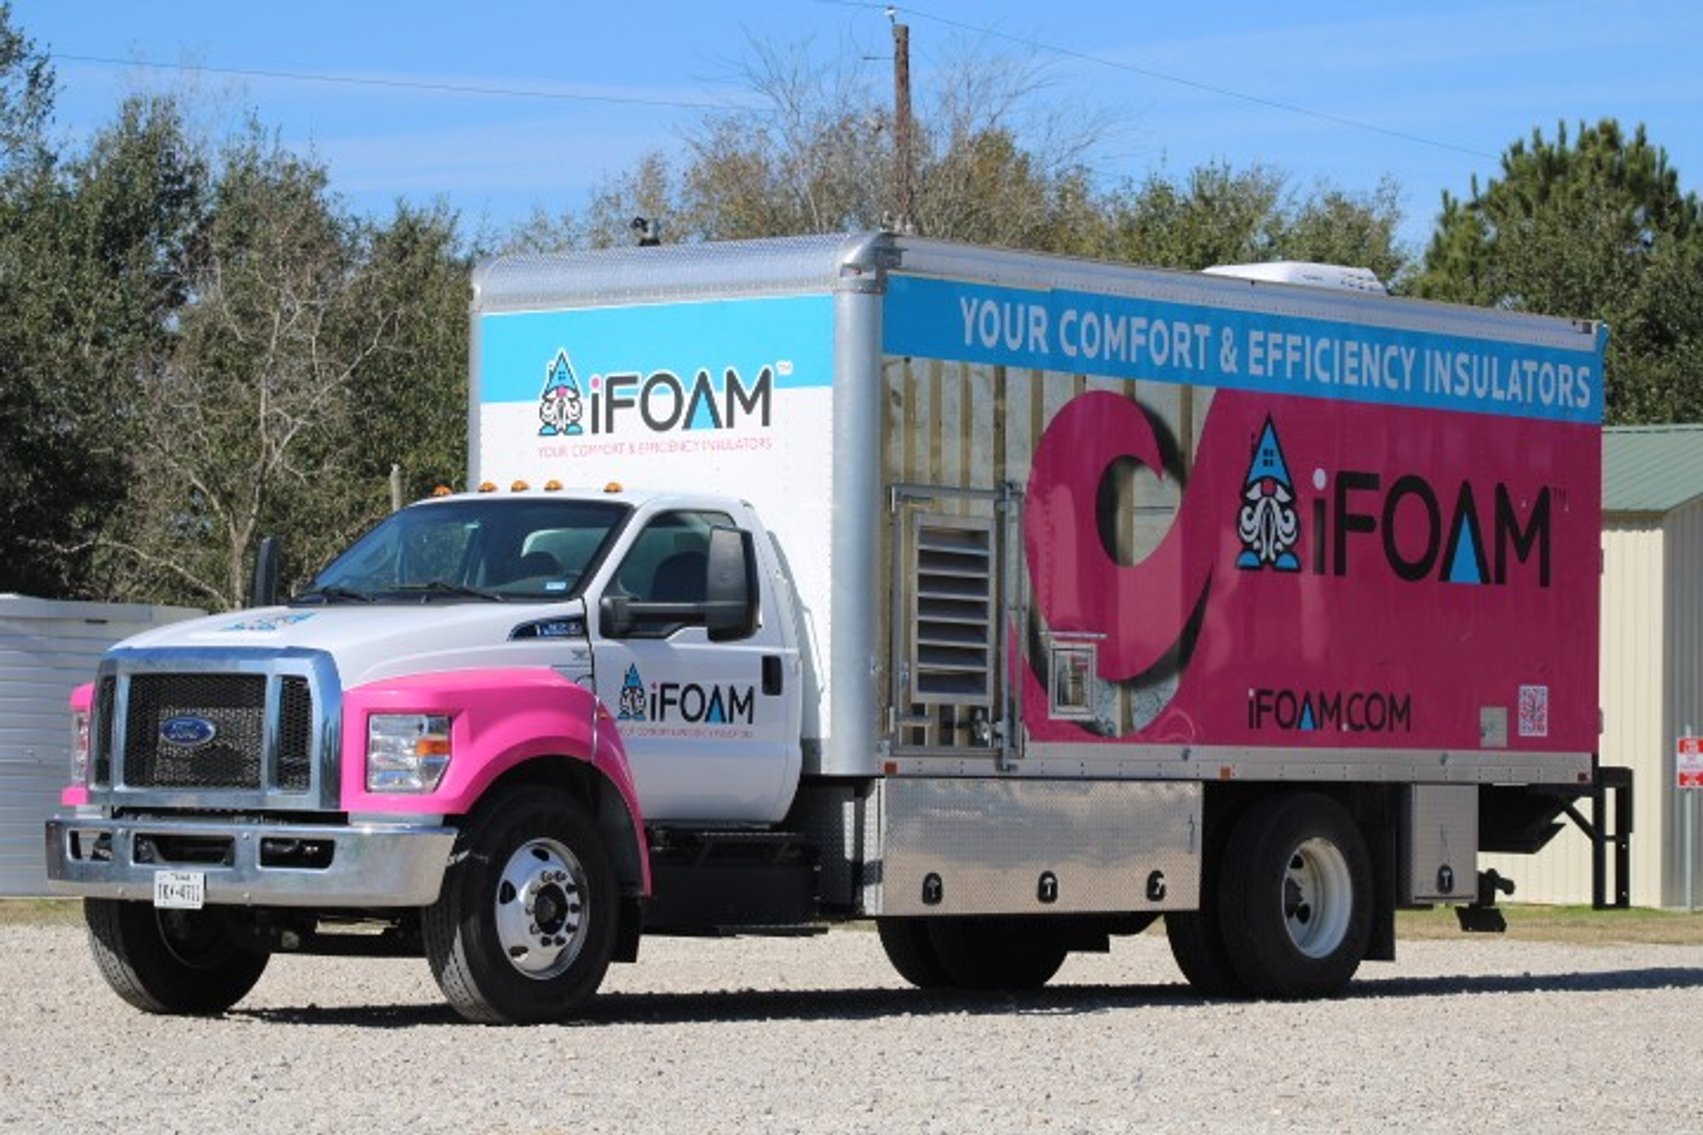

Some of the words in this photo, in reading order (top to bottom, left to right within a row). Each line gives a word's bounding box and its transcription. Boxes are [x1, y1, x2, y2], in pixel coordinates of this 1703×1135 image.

[960, 296, 1049, 354] YOUR
[1059, 309, 1211, 371] COMFORT
[1219, 326, 1238, 374] &
[1248, 329, 1415, 392] EFFICIENCY
[1424, 348, 1591, 408] INSULATORS
[590, 366, 772, 434] iFOAM
[1312, 467, 1550, 588] iFOAM
[650, 681, 754, 725] iFOAM
[1248, 688, 1411, 733] iFOAM.COM
